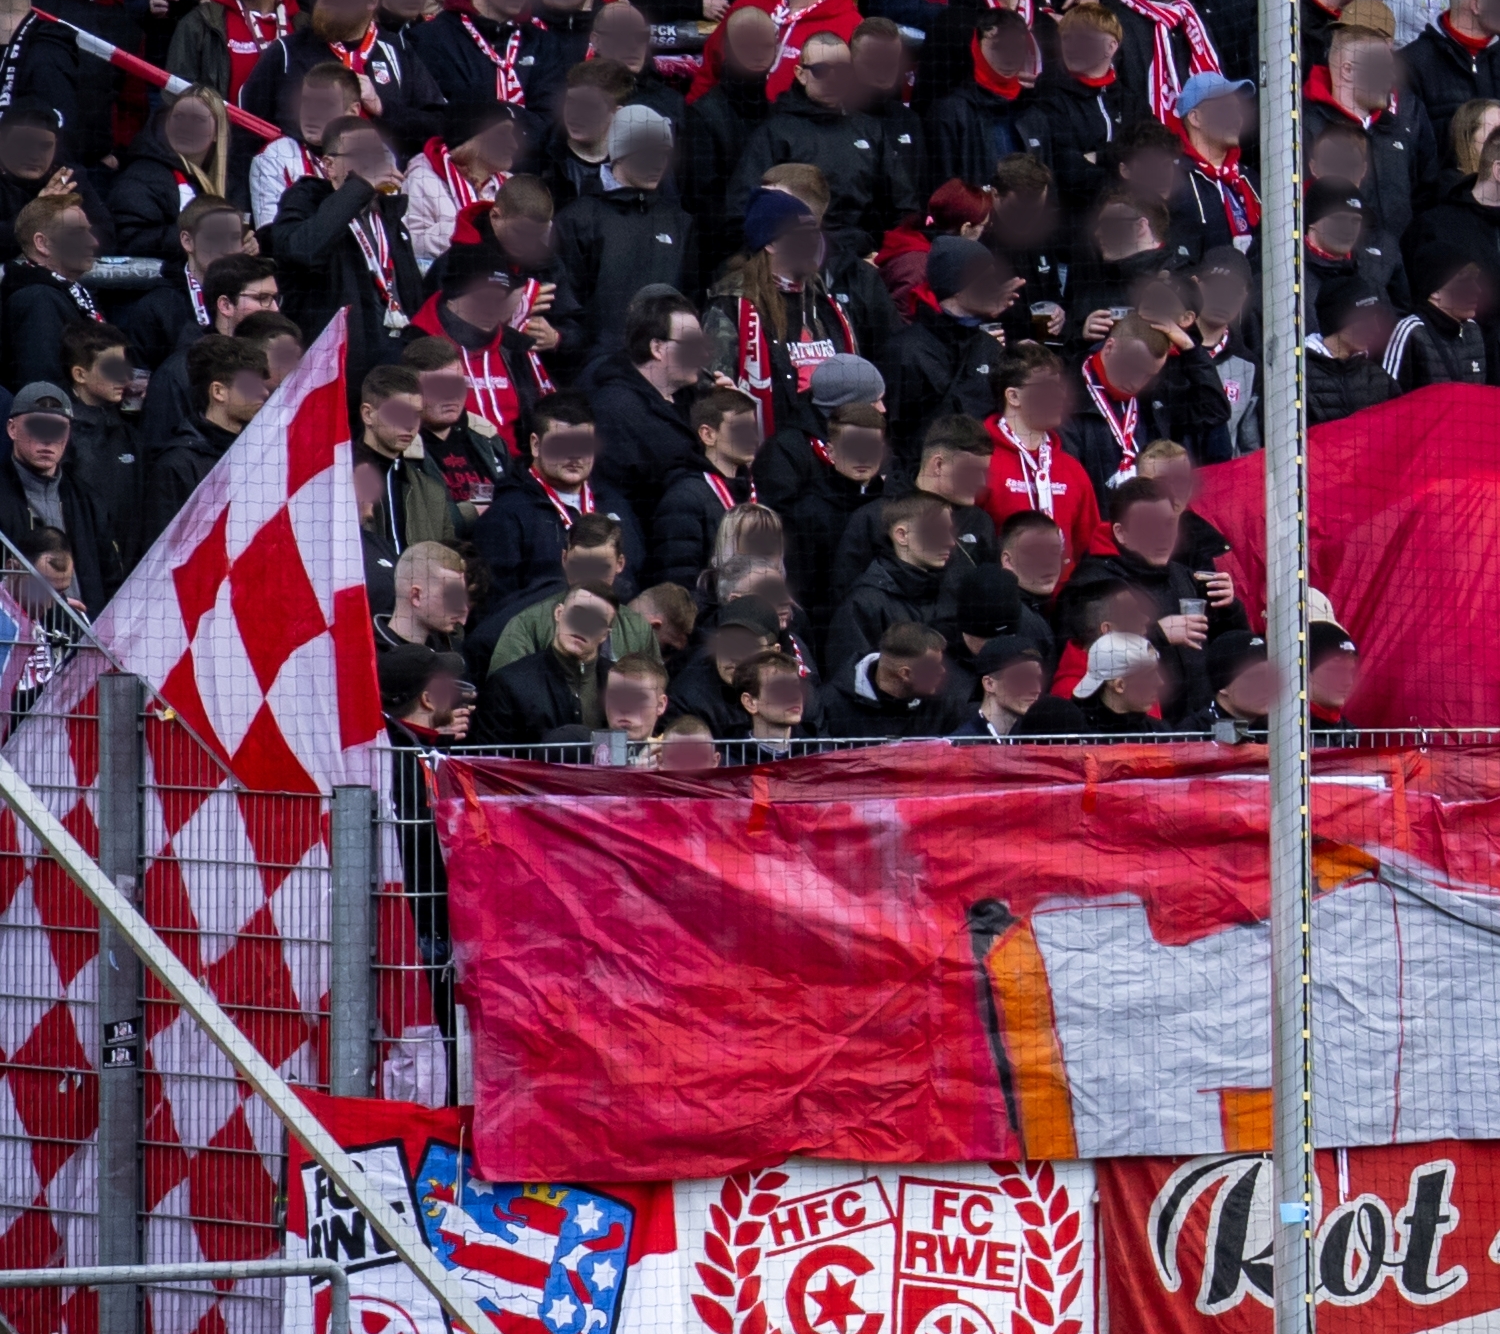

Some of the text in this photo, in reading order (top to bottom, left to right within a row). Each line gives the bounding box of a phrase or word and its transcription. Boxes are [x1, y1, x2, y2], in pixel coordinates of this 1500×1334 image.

[769, 1191, 869, 1246] HFC
[931, 1190, 994, 1236] FC
[906, 1231, 1017, 1282] RWE
